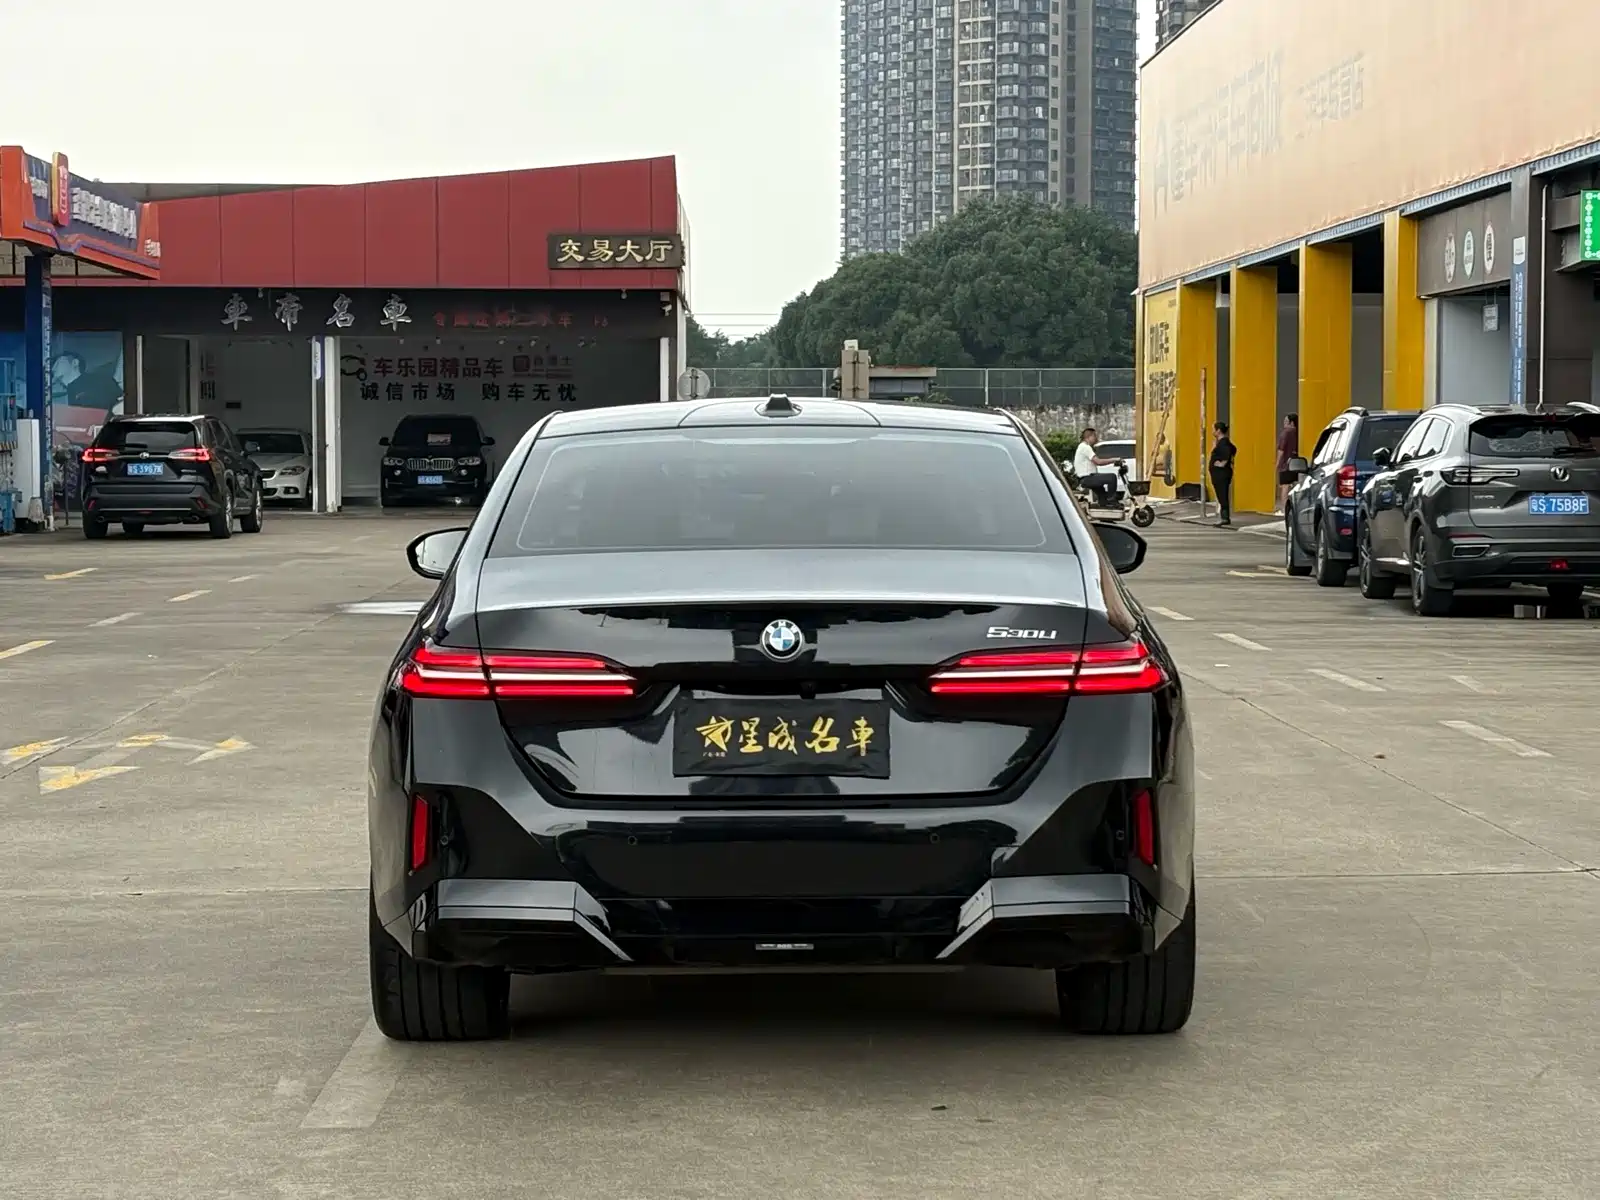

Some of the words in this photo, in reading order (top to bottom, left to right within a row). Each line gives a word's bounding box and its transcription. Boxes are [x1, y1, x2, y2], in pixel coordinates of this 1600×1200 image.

[557, 239, 674, 263] 交易大厅
[373, 357, 505, 379] 车乐园精品车
[360, 381, 456, 401] 诚信市场
[481, 382, 578, 401] 购车无忧
